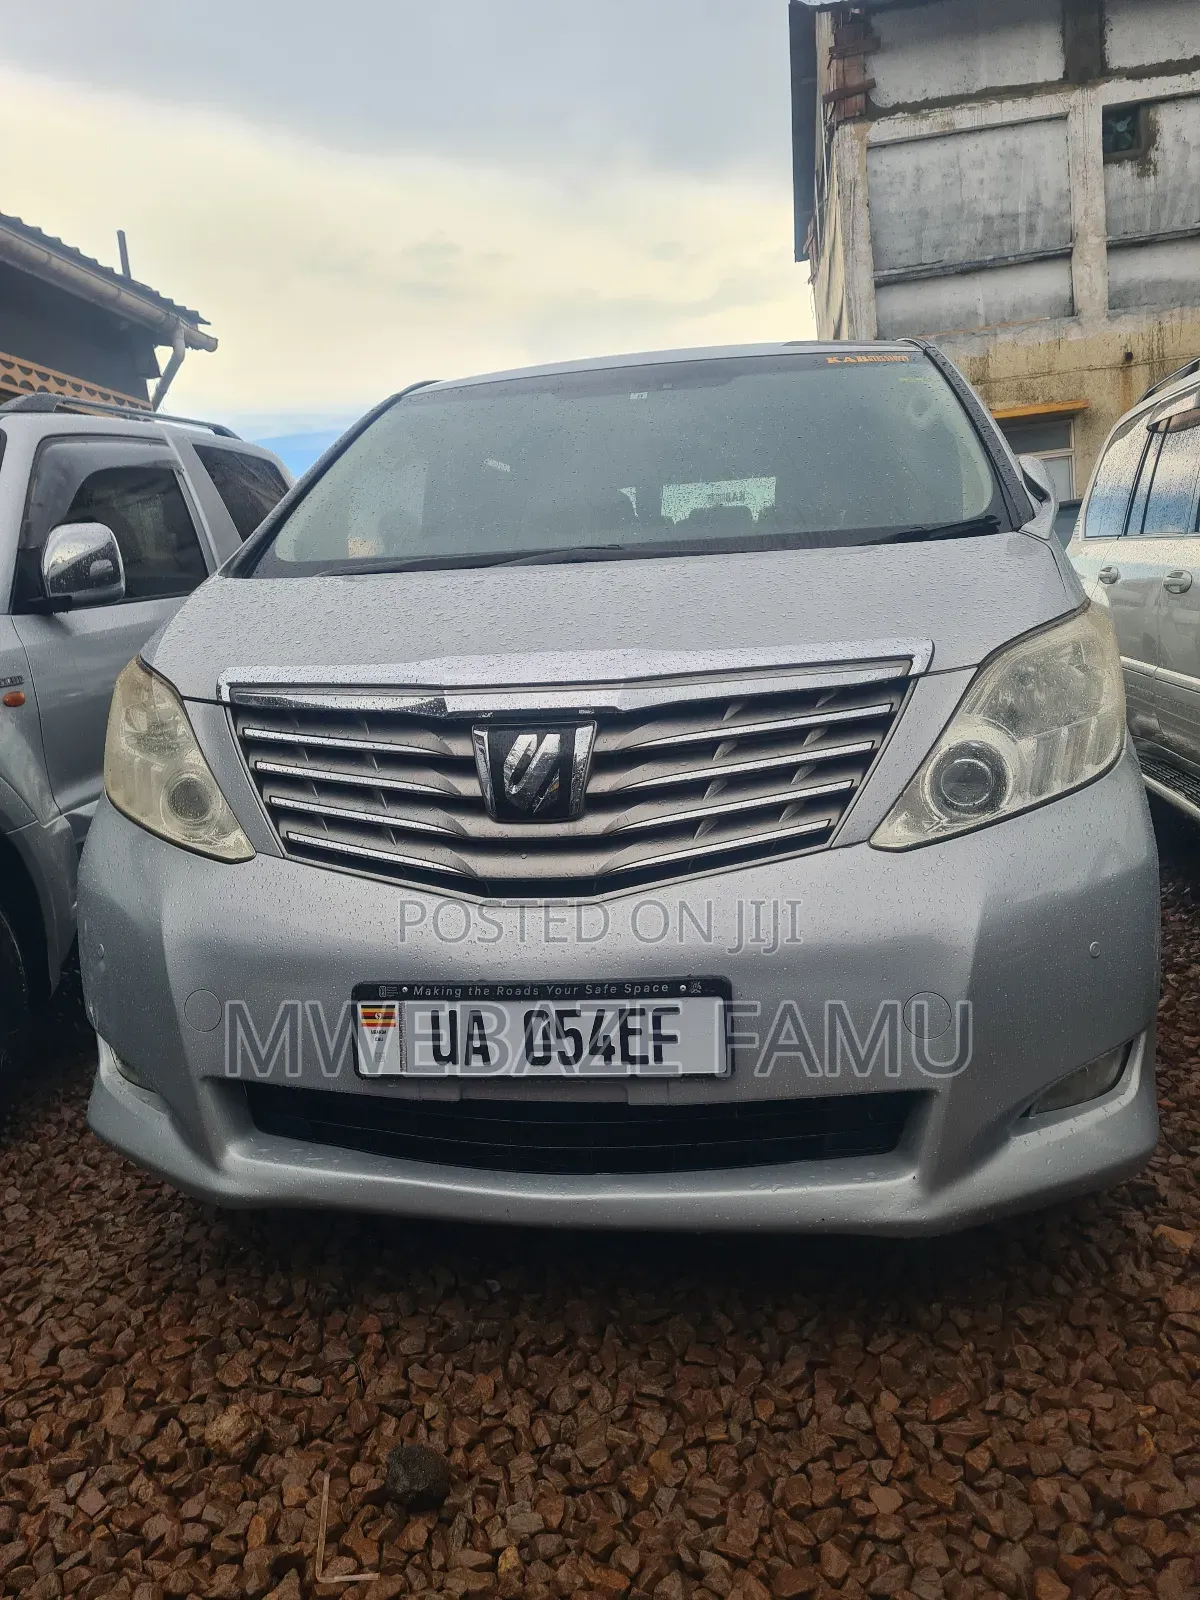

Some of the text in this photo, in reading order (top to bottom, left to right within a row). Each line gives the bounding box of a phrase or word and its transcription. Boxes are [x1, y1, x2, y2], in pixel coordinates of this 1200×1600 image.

[413, 982, 669, 998] Making the Roads Your Safe Space
[430, 1006, 681, 1066] UA 054EF
